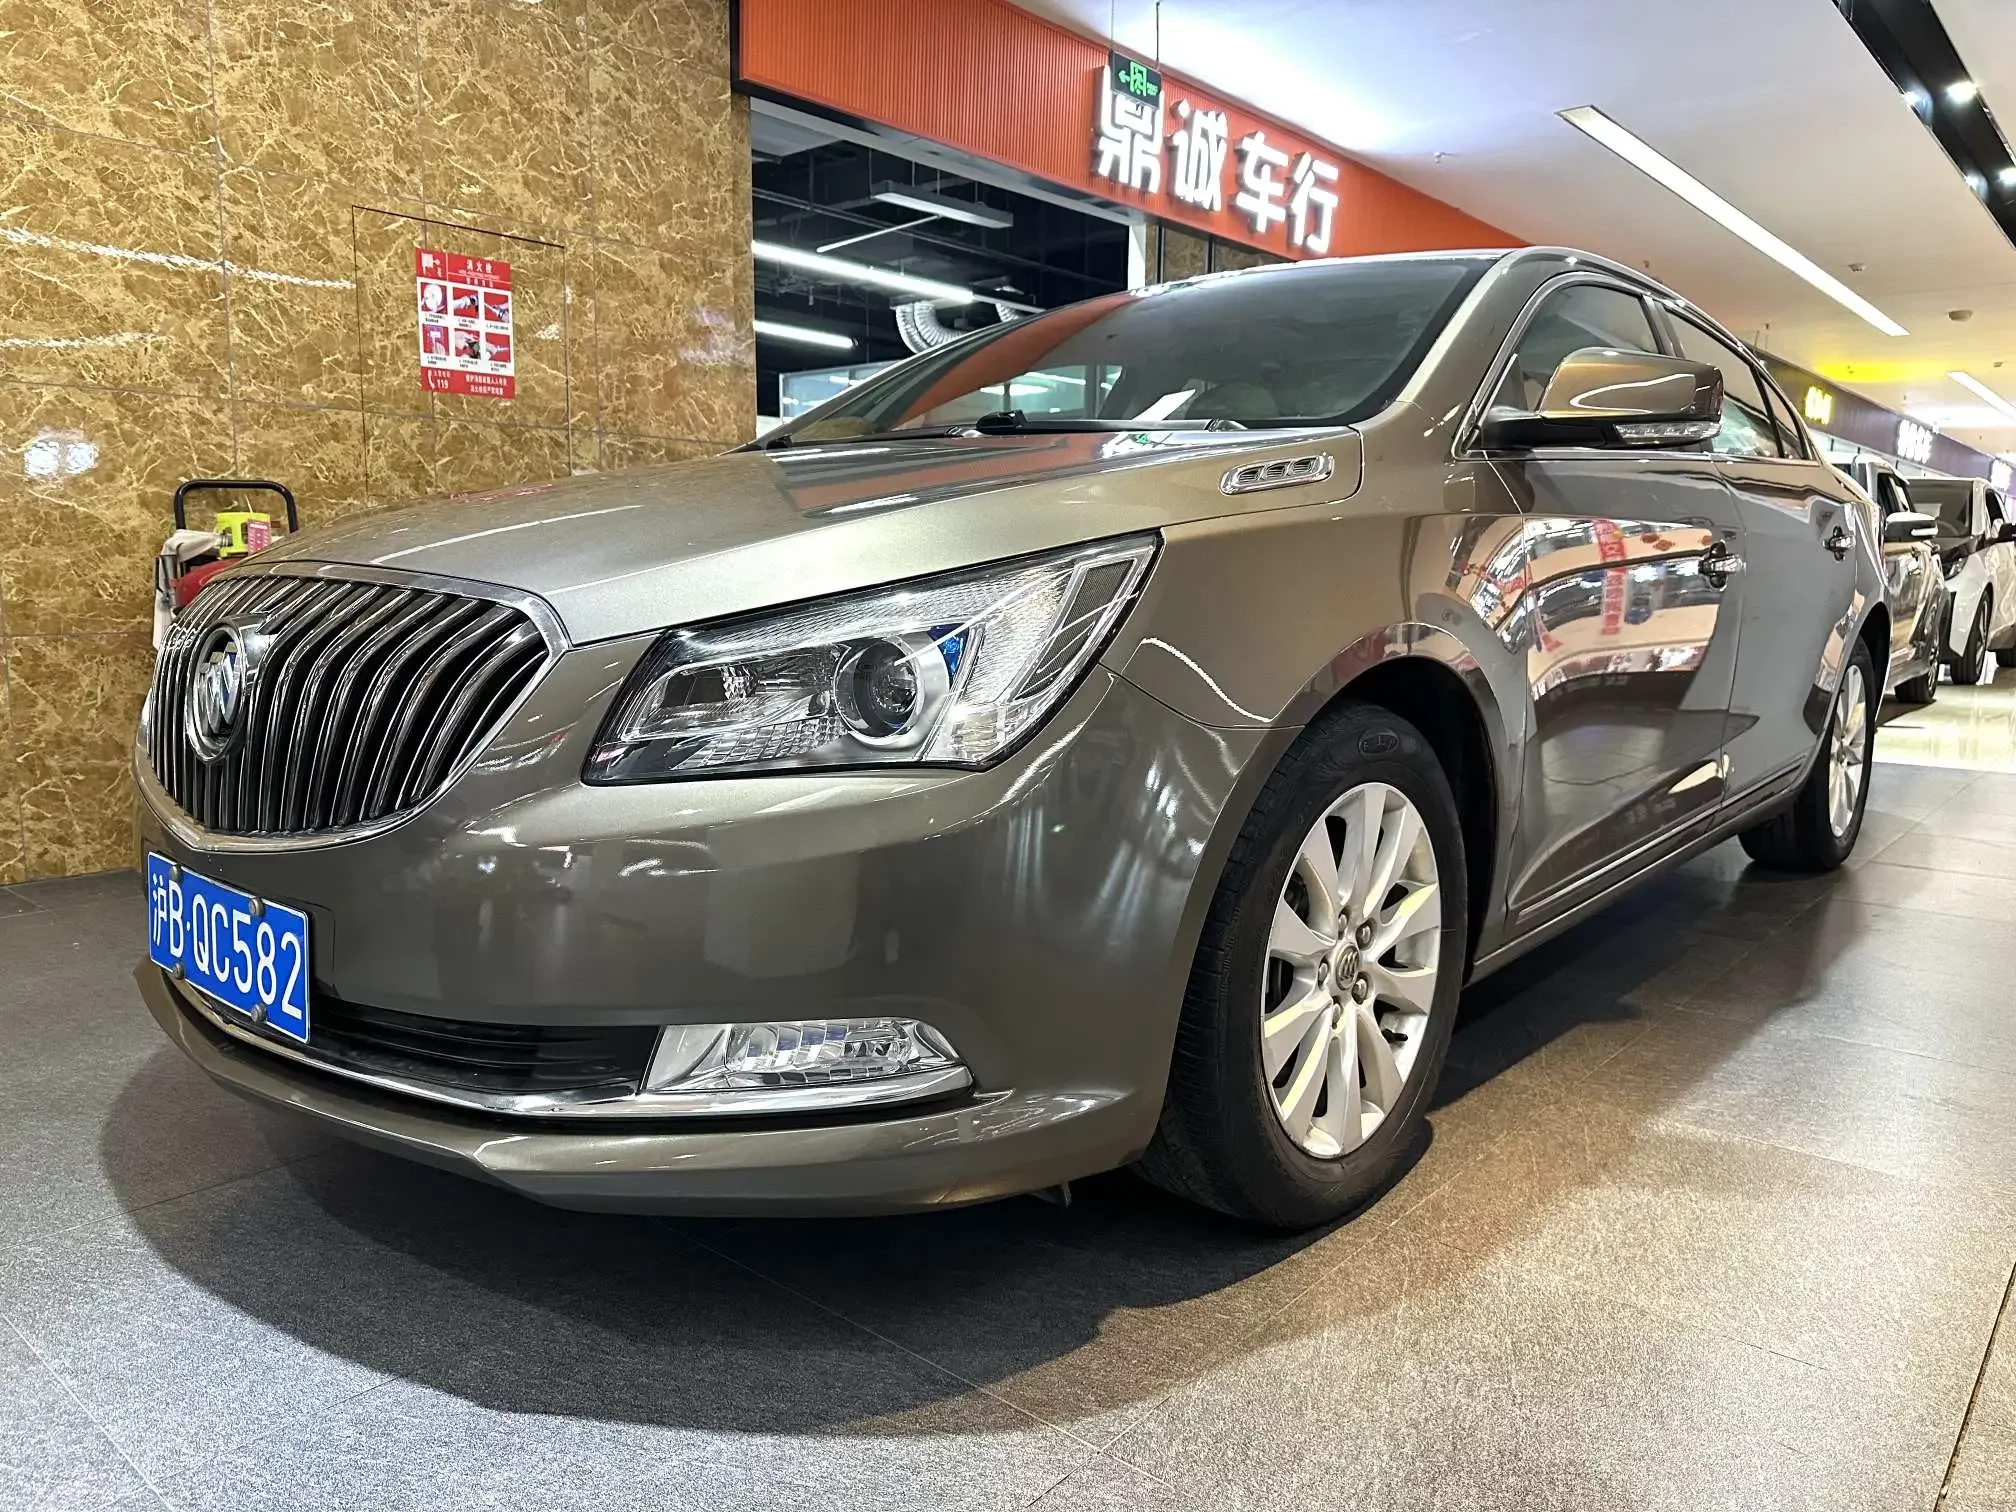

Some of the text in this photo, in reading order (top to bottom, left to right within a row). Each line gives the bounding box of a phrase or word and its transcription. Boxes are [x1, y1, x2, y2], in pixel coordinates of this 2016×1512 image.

[1097, 64, 1339, 253] 鼎诚车行
[436, 378, 449, 390] 119
[152, 872, 303, 1020] 沪B·QC582
